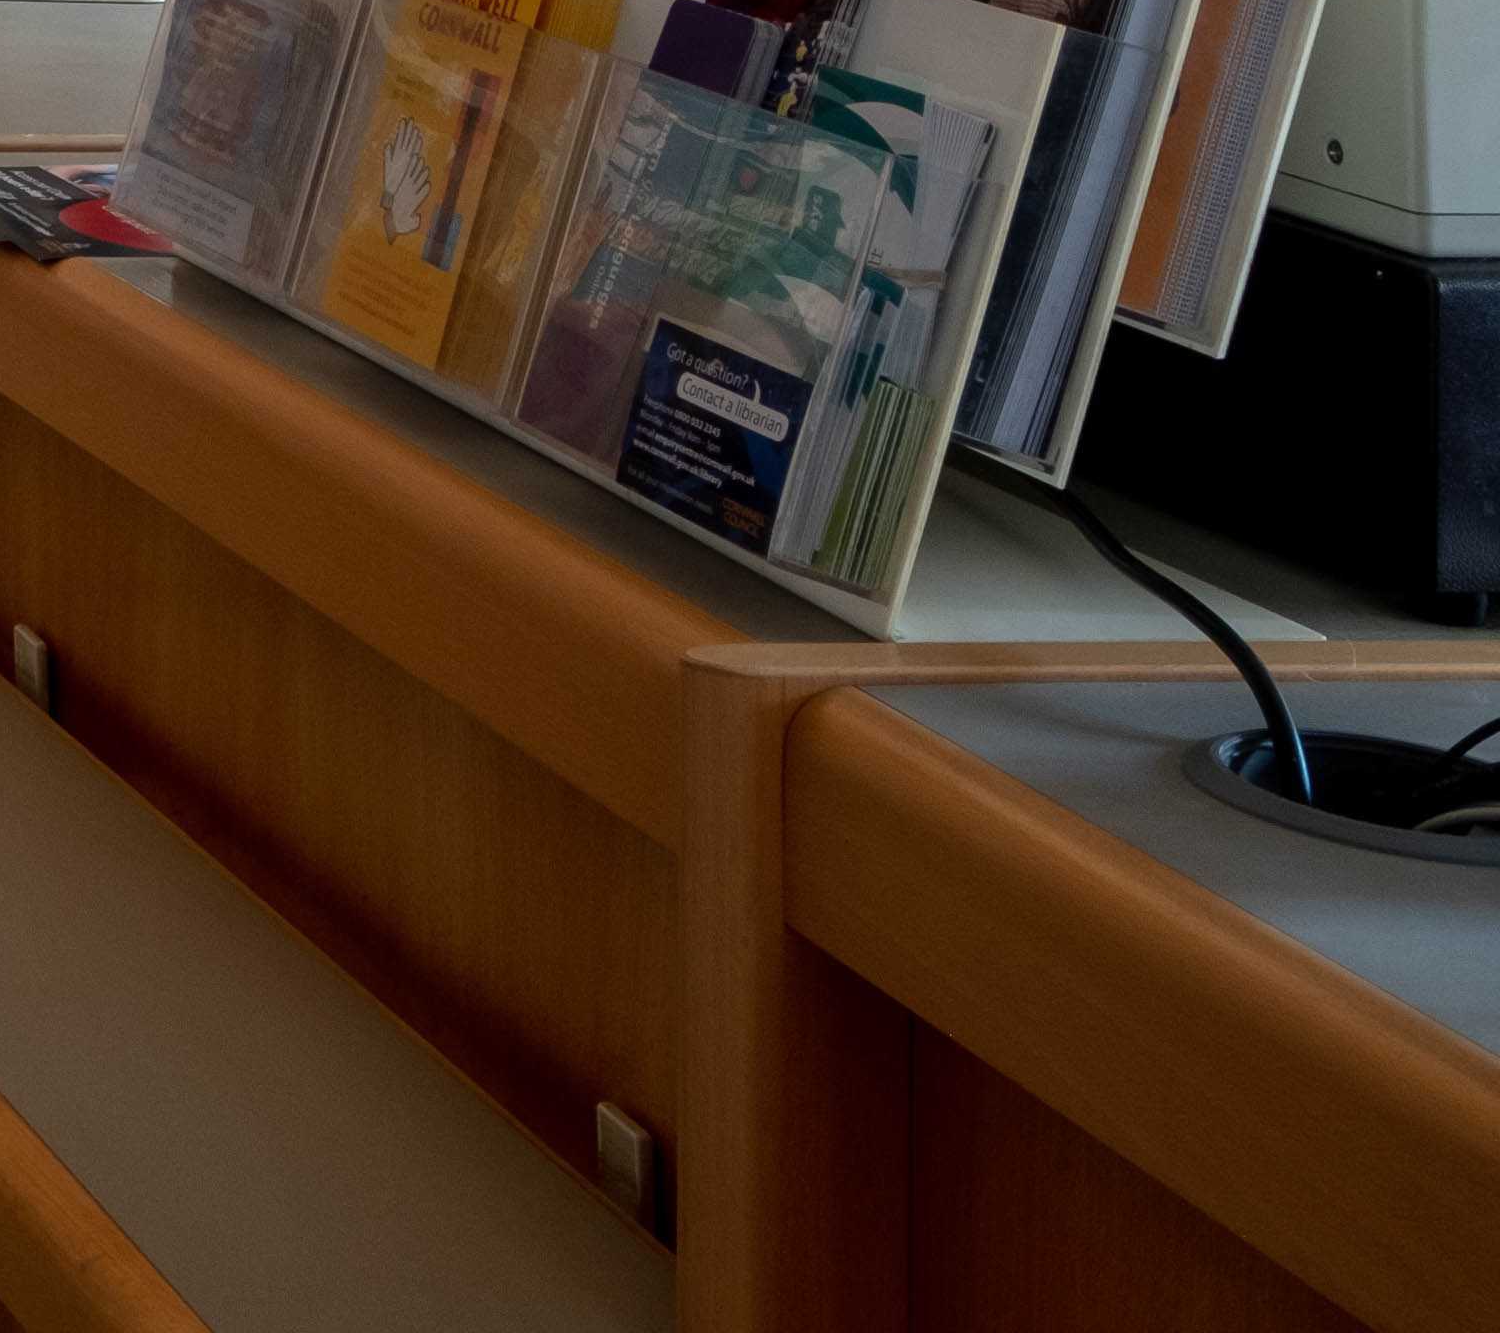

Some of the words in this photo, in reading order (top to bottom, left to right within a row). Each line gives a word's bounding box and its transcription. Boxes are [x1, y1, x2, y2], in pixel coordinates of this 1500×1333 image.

[666, 342, 683, 362] Got
[694, 354, 750, 390] question?
[682, 377, 726, 412] Contact
[724, 397, 734, 413] a
[733, 395, 784, 436] librarian
